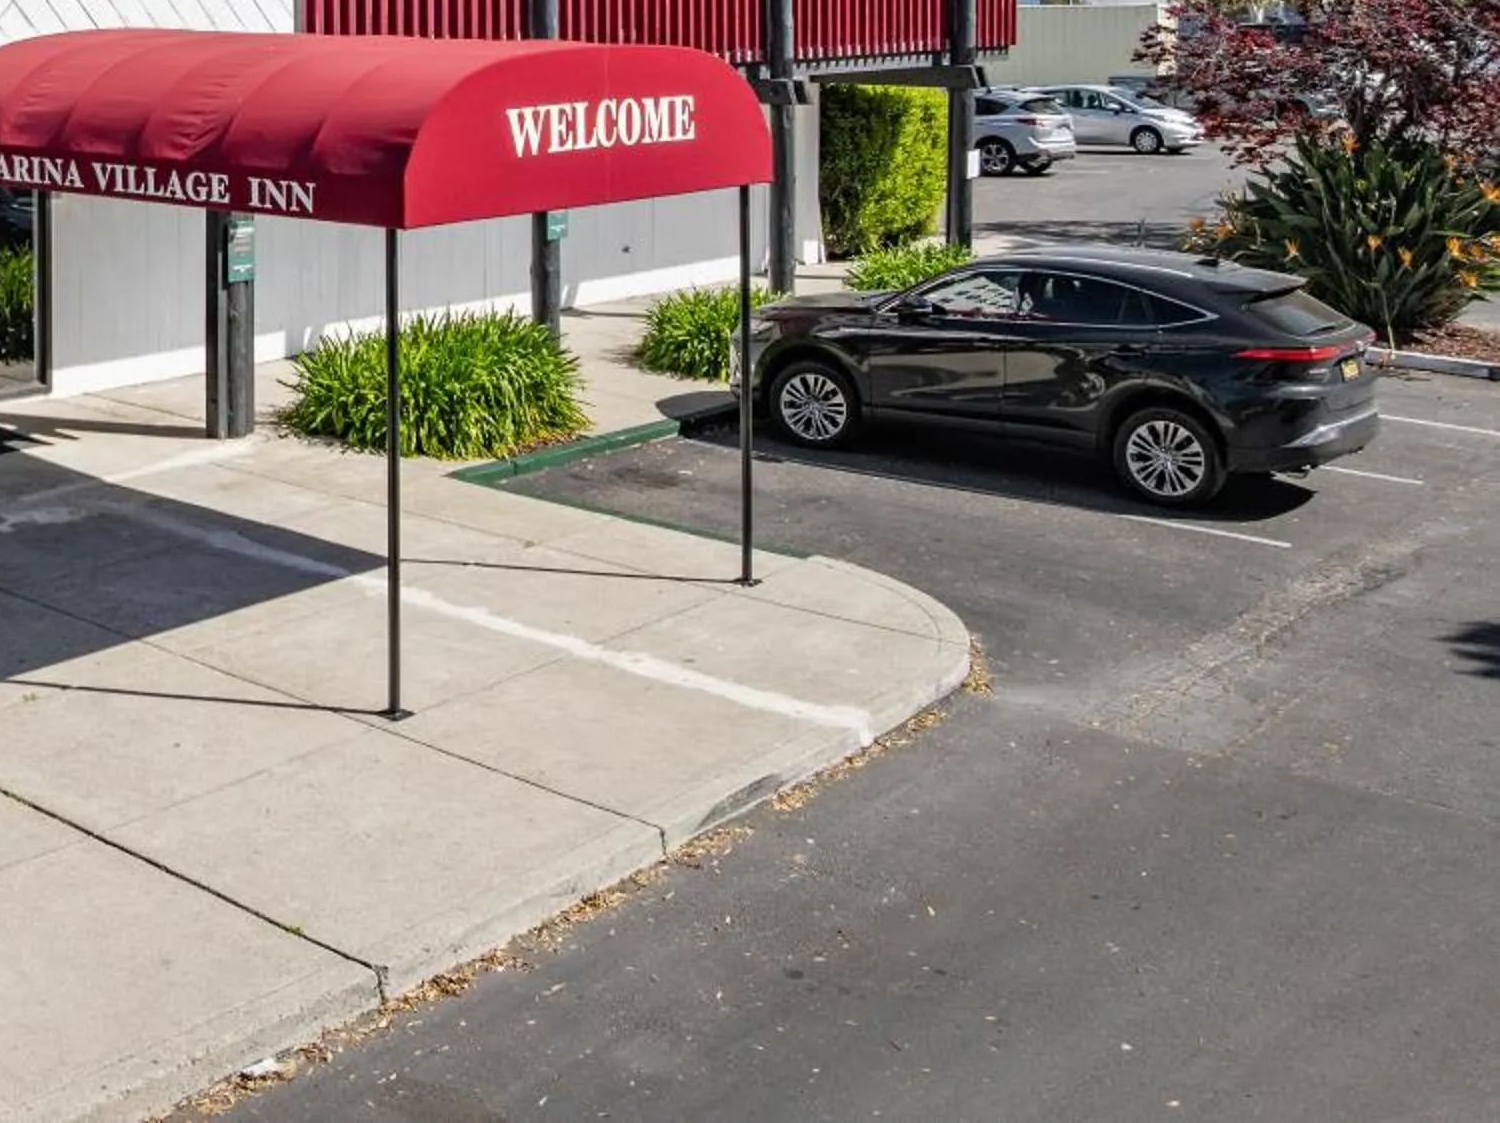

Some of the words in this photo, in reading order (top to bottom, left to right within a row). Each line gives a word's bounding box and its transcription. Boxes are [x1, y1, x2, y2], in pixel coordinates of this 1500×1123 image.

[505, 94, 695, 158] WELCOME
[91, 161, 231, 204] VILLAGE
[247, 176, 316, 214] INN
